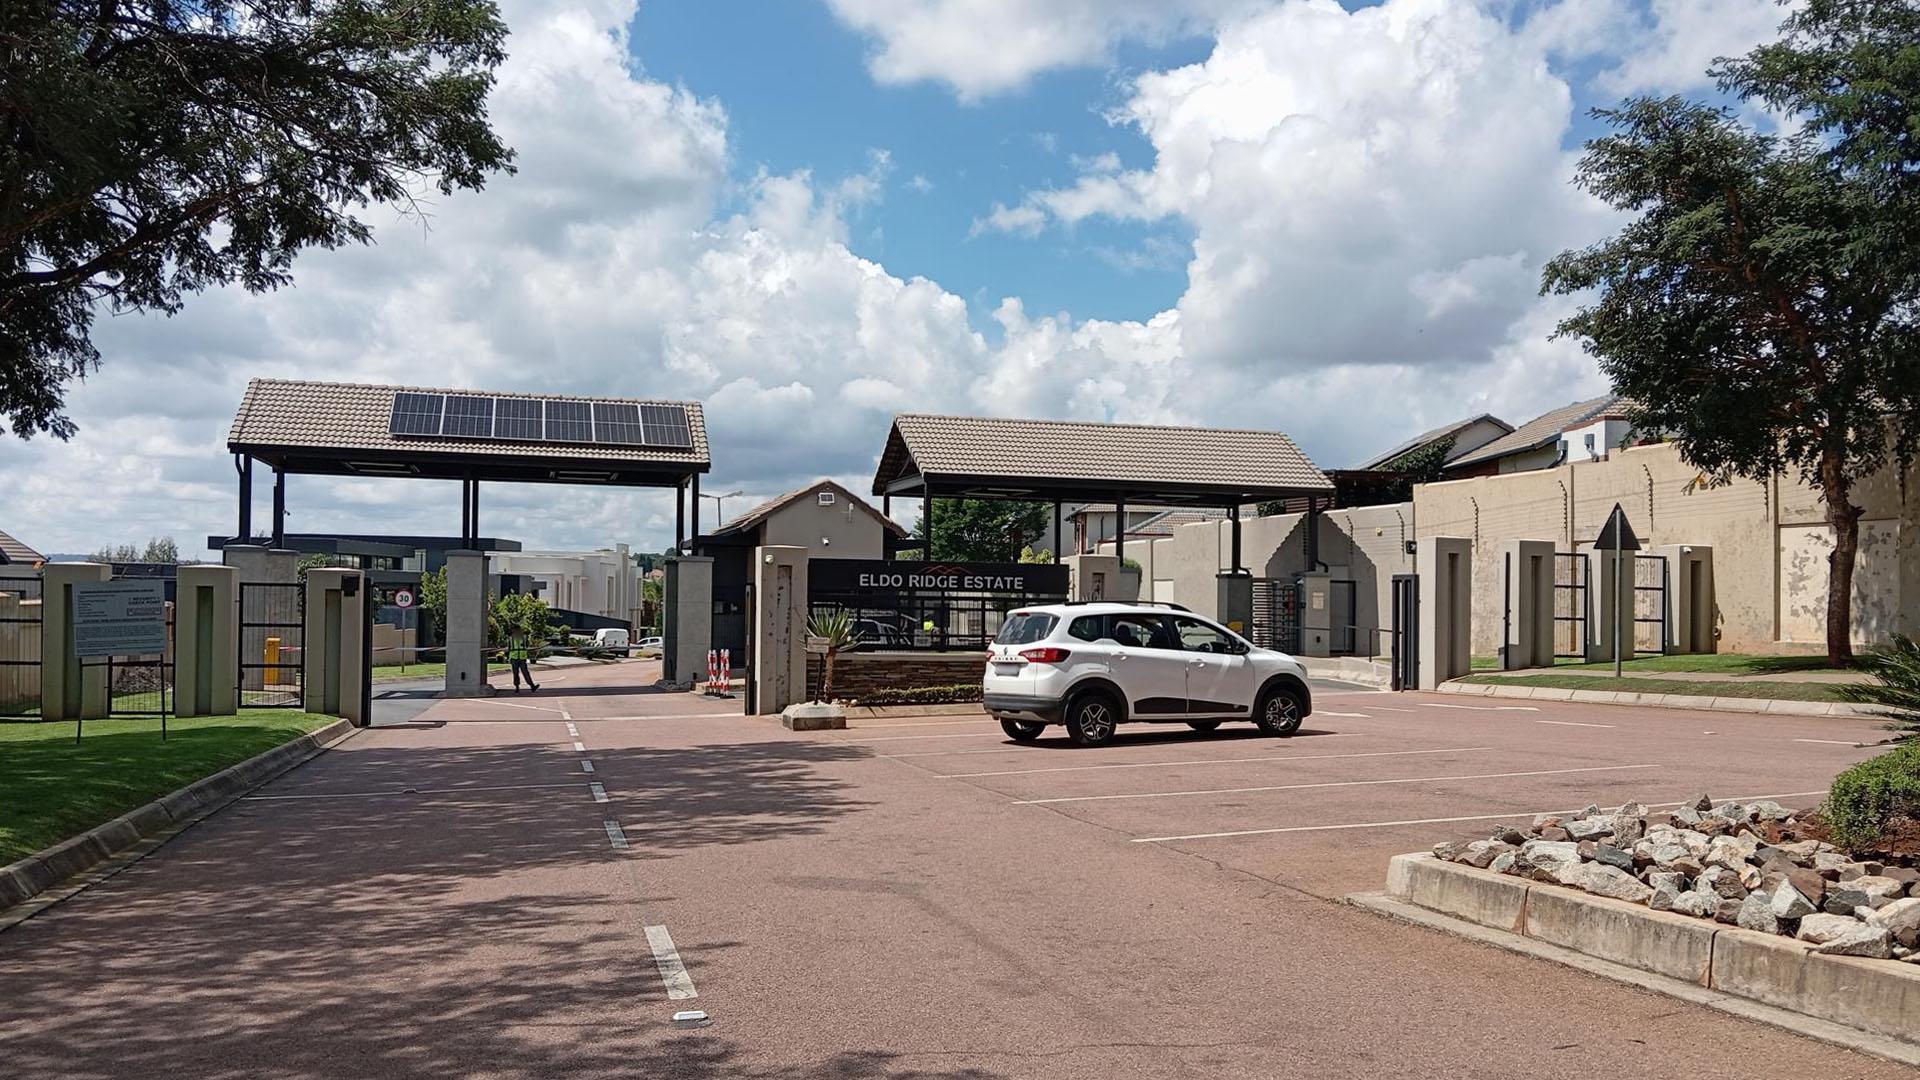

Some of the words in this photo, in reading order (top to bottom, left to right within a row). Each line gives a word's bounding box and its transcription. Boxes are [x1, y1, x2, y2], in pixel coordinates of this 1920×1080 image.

[859, 574, 903, 587] ELDO
[908, 574, 958, 588] RIDGE
[964, 576, 1024, 589] ESTATE
